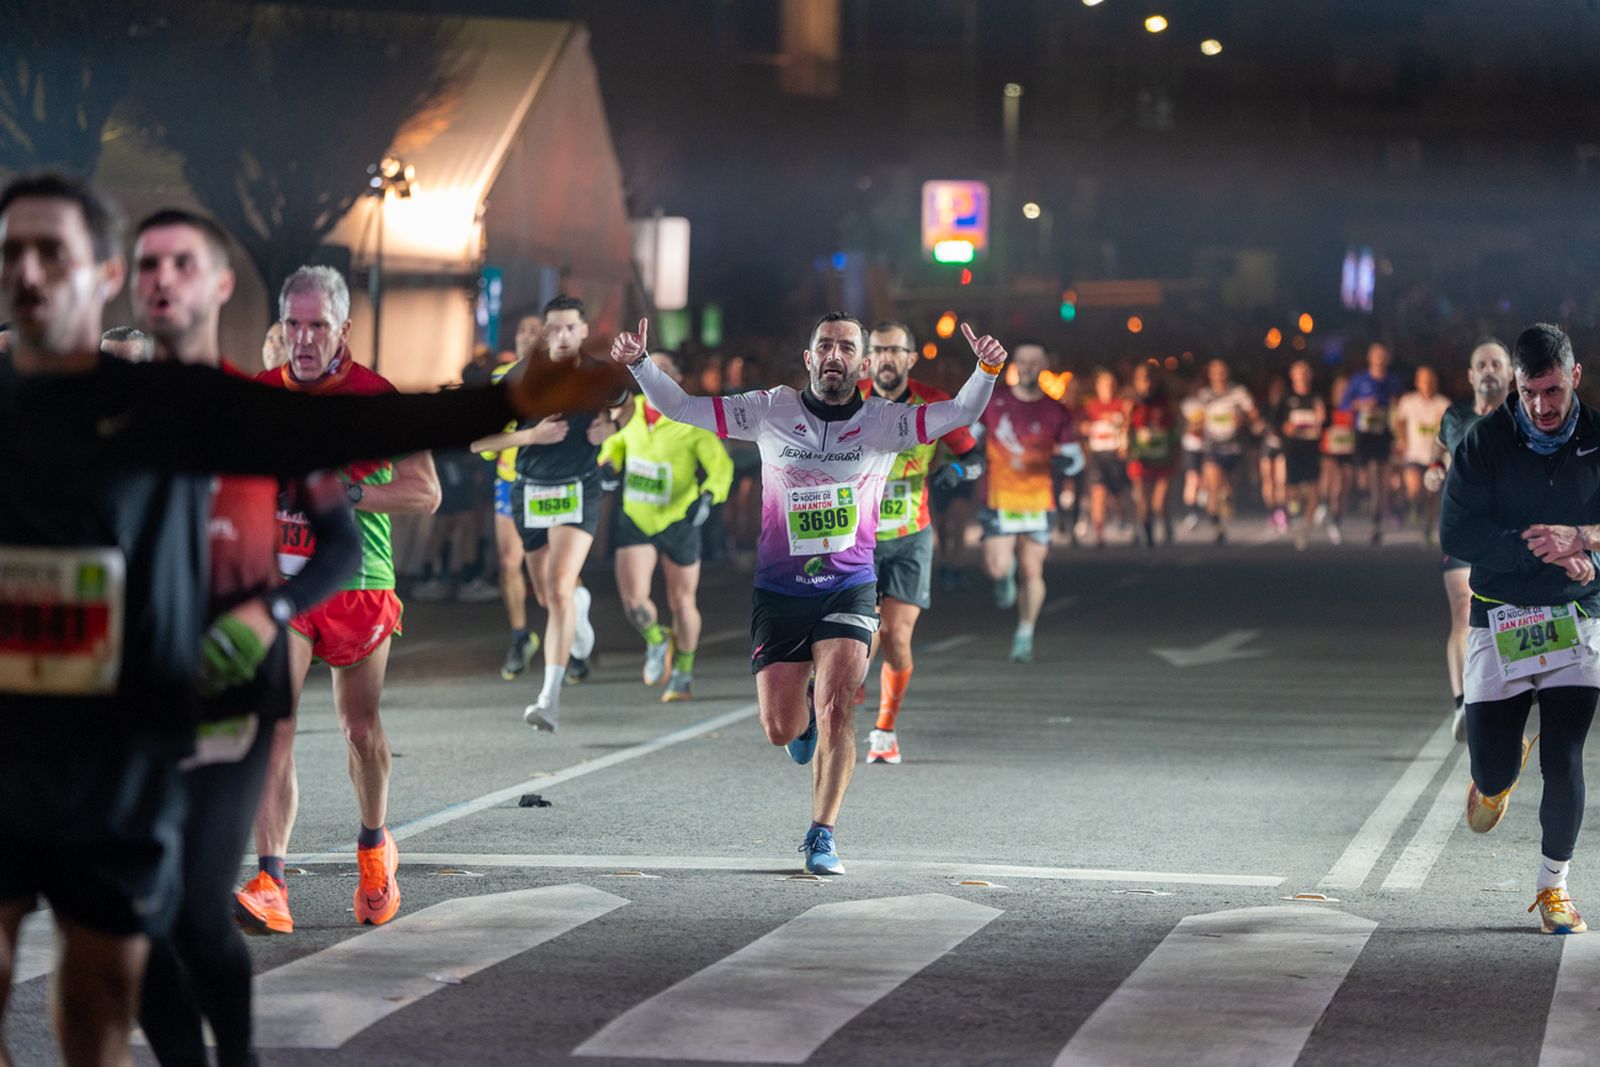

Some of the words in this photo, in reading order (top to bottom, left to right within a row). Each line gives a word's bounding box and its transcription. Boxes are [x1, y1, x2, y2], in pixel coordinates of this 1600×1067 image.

[779, 446, 811, 461] SIERRA
[820, 451, 860, 462] SEGURA
[800, 494, 821, 502] NOCHE
[823, 492, 832, 500] DE
[793, 503, 806, 511] SAN
[799, 508, 849, 532] 3696
[1500, 620, 1516, 633] SAN
[1516, 621, 1558, 651] 294
